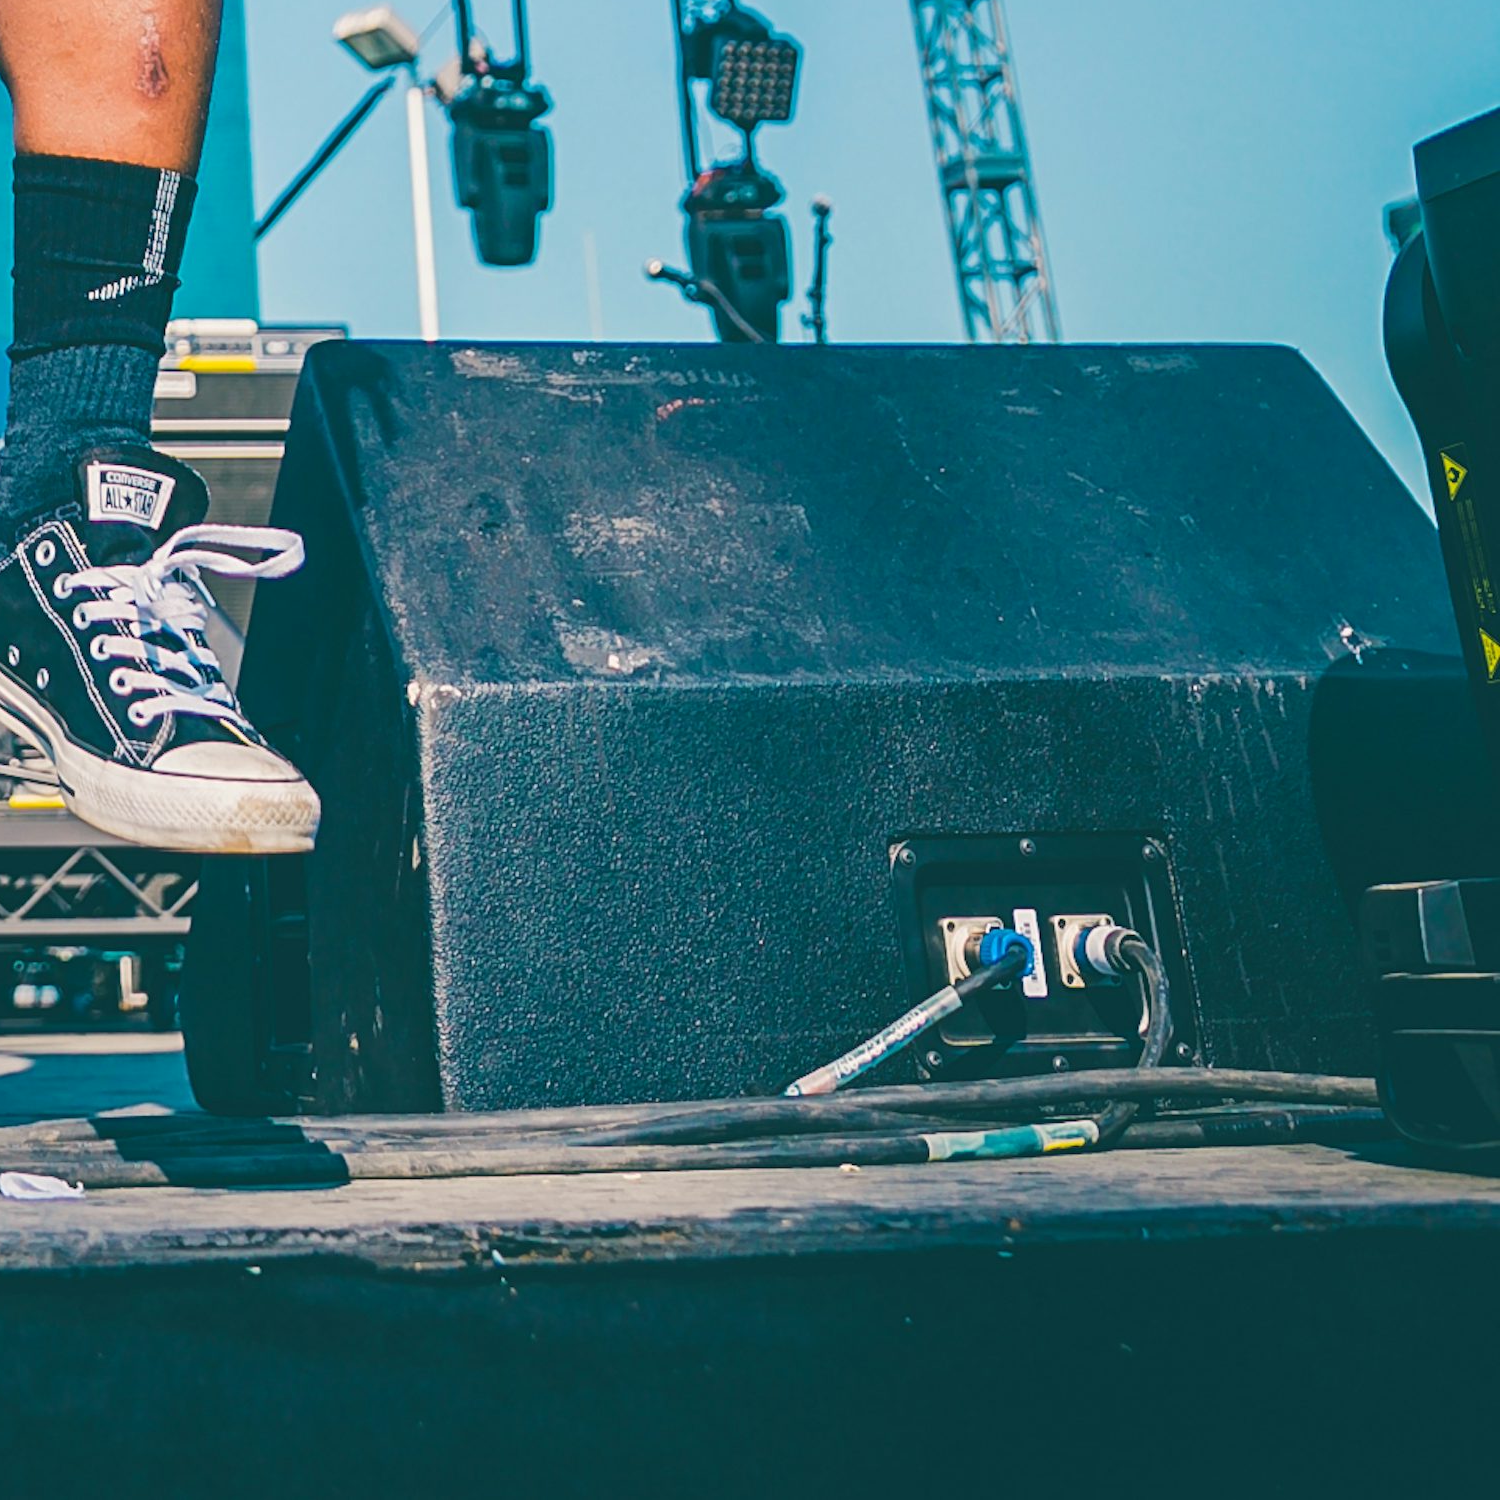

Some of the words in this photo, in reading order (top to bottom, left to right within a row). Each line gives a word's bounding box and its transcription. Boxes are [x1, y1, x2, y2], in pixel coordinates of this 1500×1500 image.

[105, 471, 157, 491] CONVERSE
[105, 487, 124, 509] ALL
[133, 491, 154, 517] STAR
